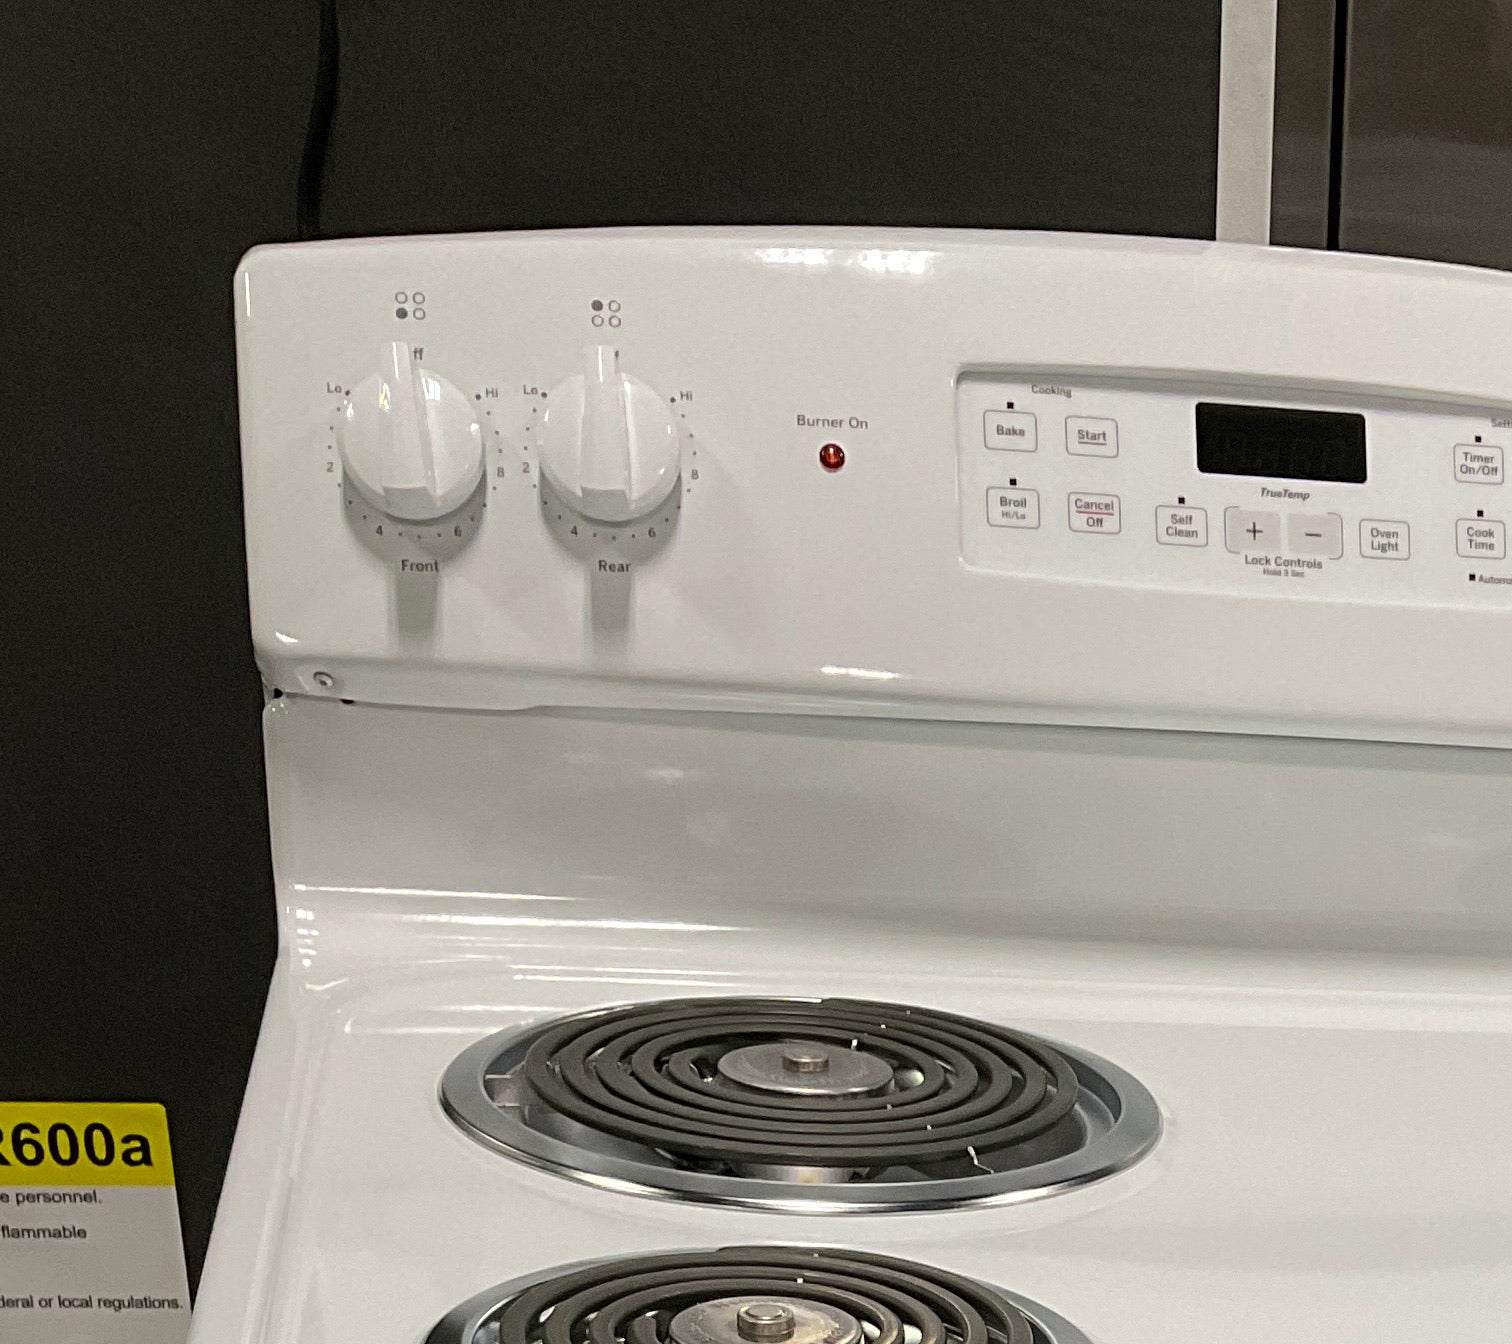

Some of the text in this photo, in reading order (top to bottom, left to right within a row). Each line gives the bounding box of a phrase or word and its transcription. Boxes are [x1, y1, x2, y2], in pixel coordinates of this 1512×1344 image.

[326, 382, 342, 394] Lo
[485, 387, 499, 398] Hi
[523, 384, 538, 396] Lo
[1031, 384, 1072, 398] Cooking
[680, 390, 693, 401] Hi
[796, 415, 869, 430] Burner On
[996, 423, 1025, 437] Bake
[1077, 429, 1107, 442] Start
[1463, 451, 1495, 464] Timer
[326, 461, 334, 473] 2
[522, 462, 530, 474] 2
[1459, 463, 1498, 477] On/Off
[1260, 487, 1311, 502] TrueTemp
[999, 496, 1027, 509] Broil
[1074, 498, 1114, 512] Cancel
[1086, 516, 1104, 528] Off
[1170, 513, 1193, 526] Self
[375, 525, 383, 536] 4
[570, 525, 578, 536] 4
[648, 527, 656, 538] 6
[1165, 526, 1199, 539] Clean
[1370, 527, 1399, 540] Oven
[1466, 526, 1495, 539] Cook
[1371, 540, 1400, 554] Light
[1468, 539, 1495, 551] Time
[401, 559, 440, 573] Front
[598, 560, 631, 573] Rear
[1244, 554, 1323, 570] Lock Controls
[1, 1225, 87, 1239] flammable
[38, 1297, 53, 1309] or
[57, 1294, 93, 1309] local
[97, 1294, 184, 1312] regulations.
